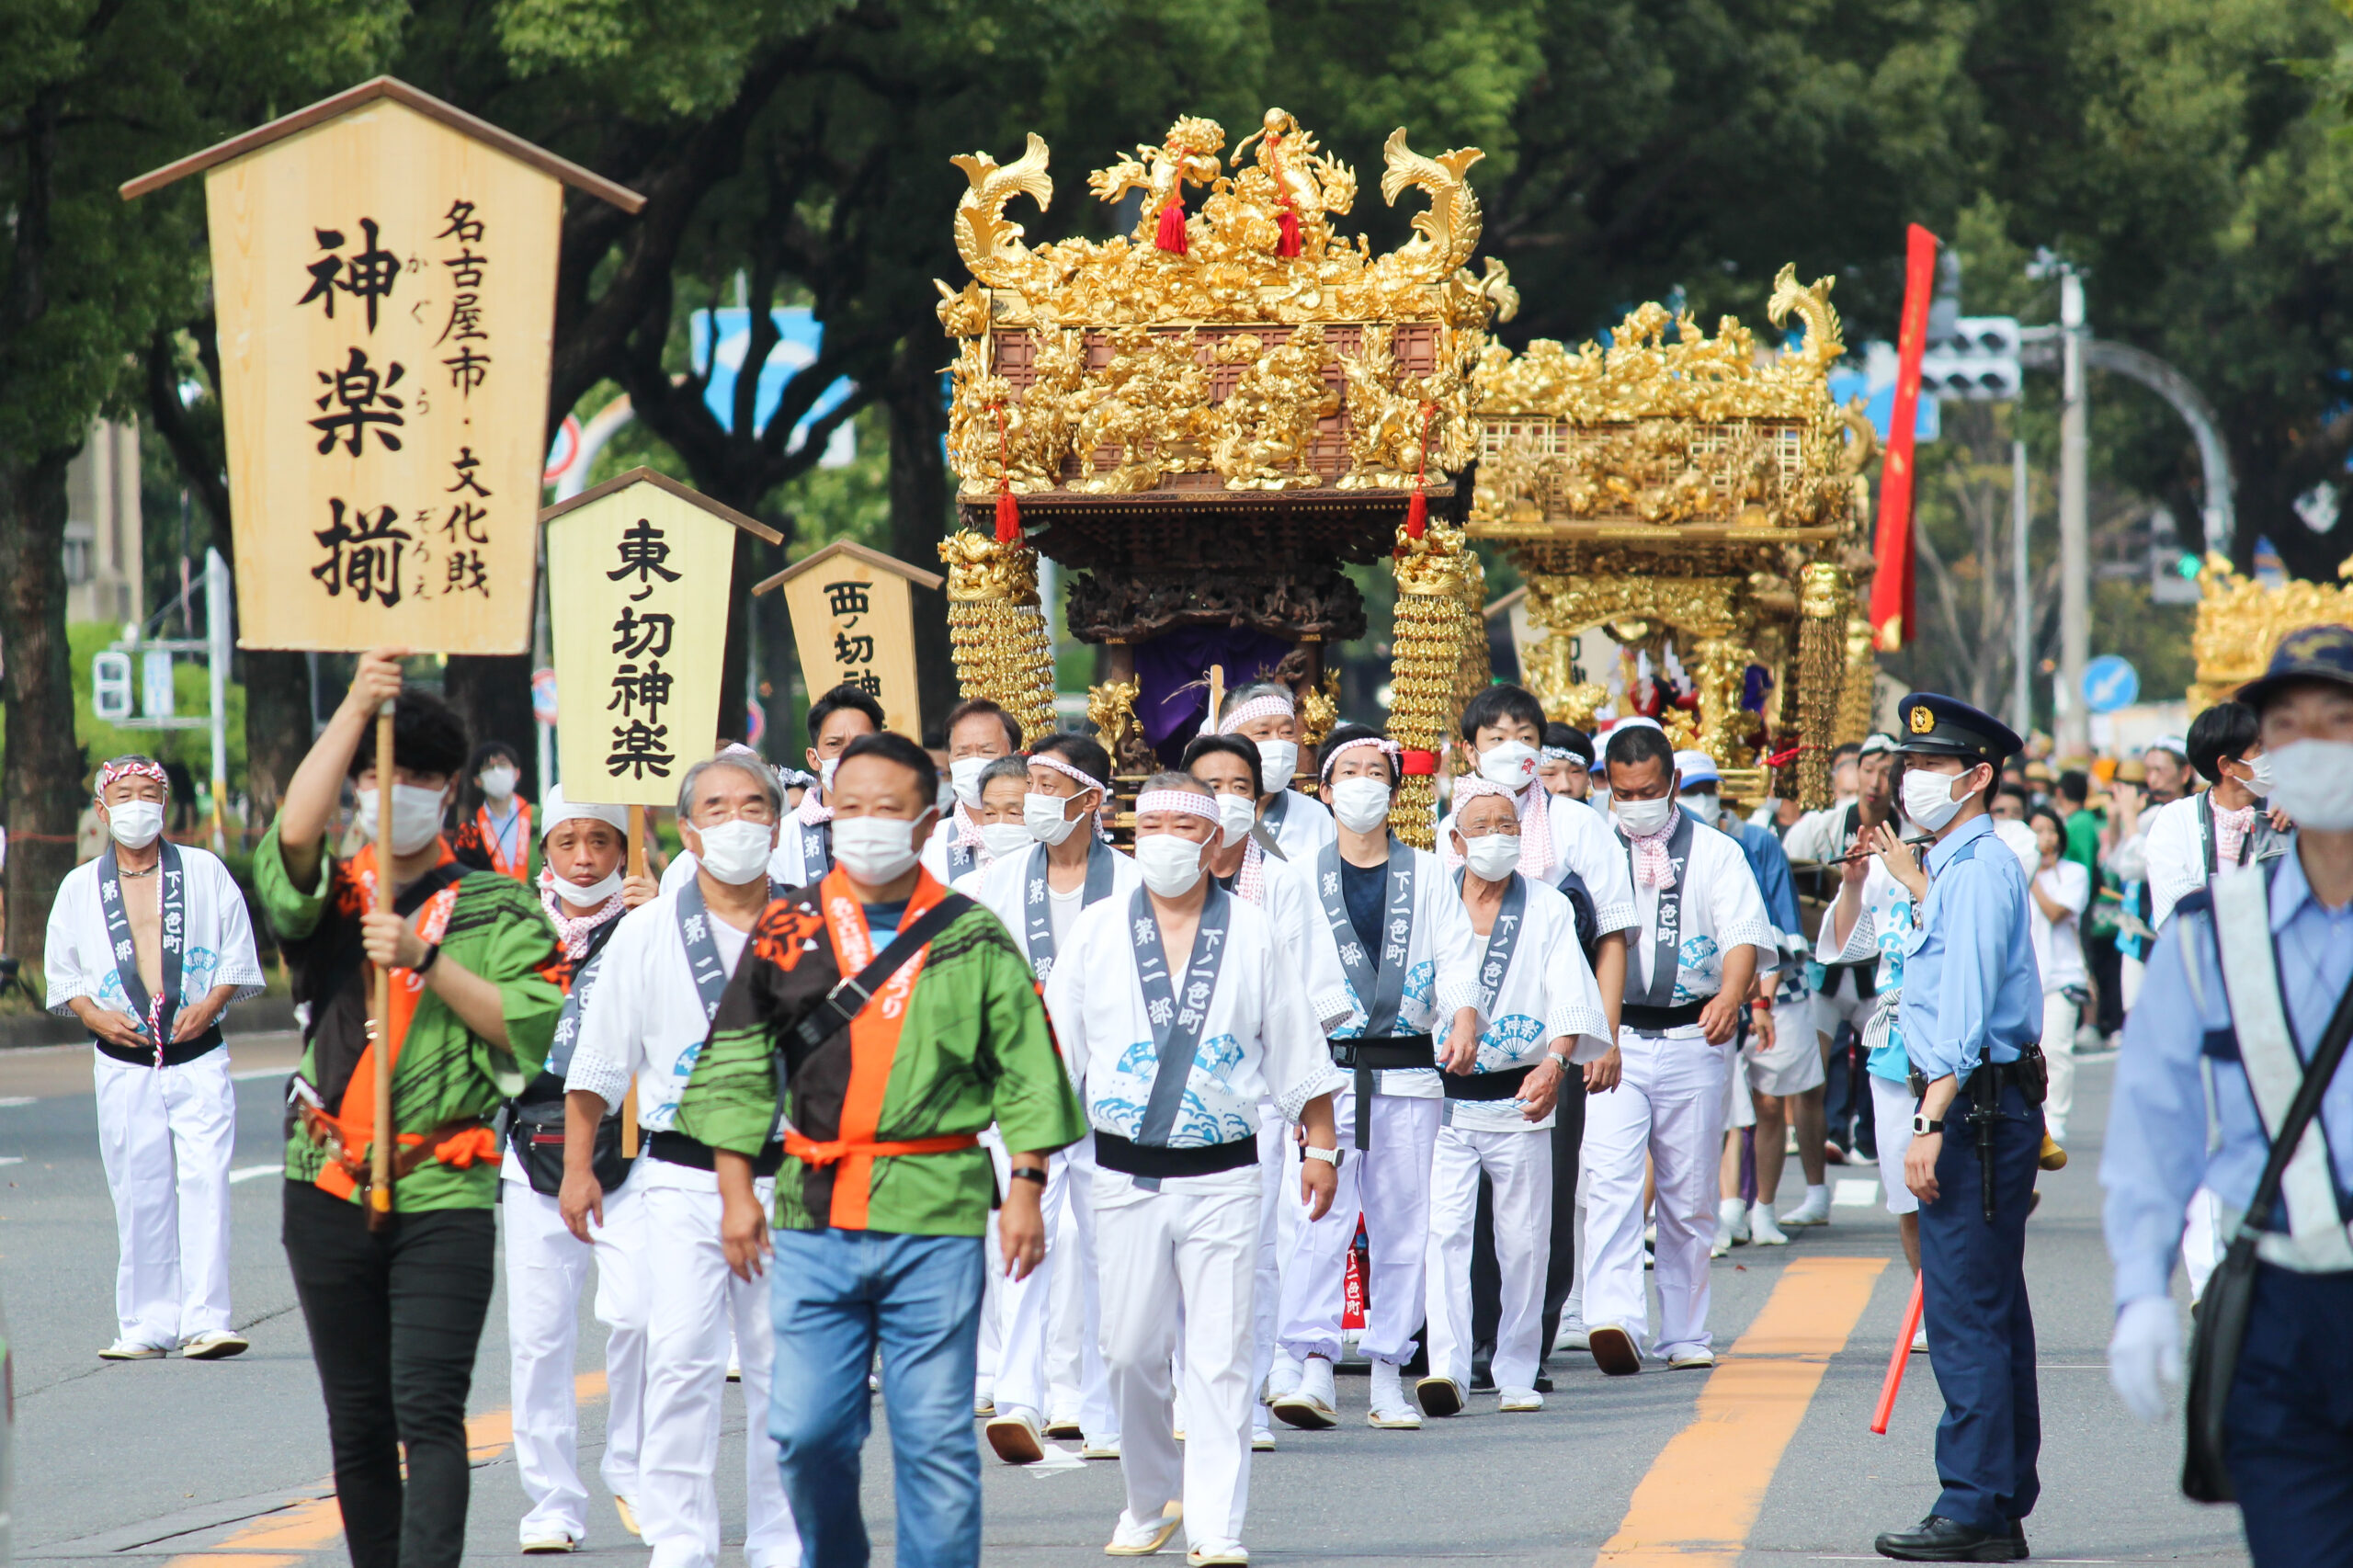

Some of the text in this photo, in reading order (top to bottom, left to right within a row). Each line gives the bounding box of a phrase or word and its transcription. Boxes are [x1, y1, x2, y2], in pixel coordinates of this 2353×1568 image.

[295, 217, 413, 609] 神楽揃
[605, 517, 683, 780] 東ノ切神楽
[824, 581, 887, 729] 西ノ切神
[101, 879, 133, 962] 第二部
[163, 869, 183, 955] 下ノ一色町
[1028, 877, 1053, 981] 第二部
[1322, 871, 1362, 967] 第二部
[1385, 870, 1412, 968] 下ノ一色町
[1657, 857, 1685, 948] 下一色町
[1134, 917, 1174, 1027] 第二部
[1177, 927, 1223, 1036] 下ノ一色町
[1488, 1016, 1540, 1045] 東神楽
[1347, 1249, 1360, 1316] 下ノ一色町
